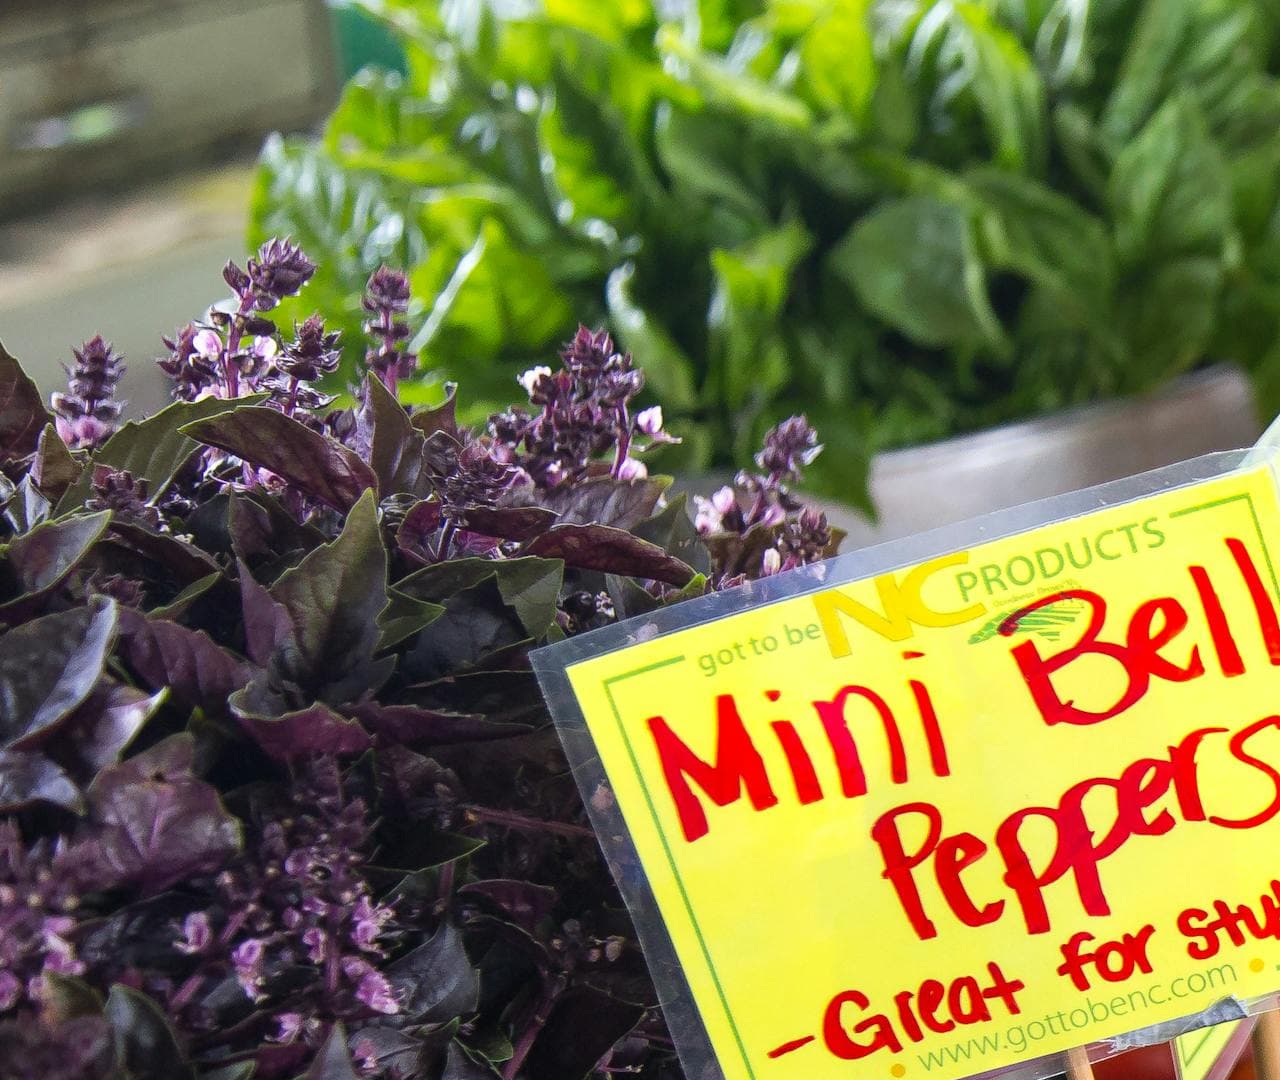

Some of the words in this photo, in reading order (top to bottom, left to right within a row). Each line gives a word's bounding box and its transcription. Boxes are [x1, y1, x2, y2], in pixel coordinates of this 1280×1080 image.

[698, 644, 743, 677] got
[749, 634, 779, 656] to
[786, 623, 821, 646] be
[811, 550, 988, 660] NC
[955, 516, 1166, 603] PRODUCTS
[646, 649, 951, 843] Mini
[916, 962, 1238, 1072] www.gottobenc.com
[1056, 923, 1156, 993] for
